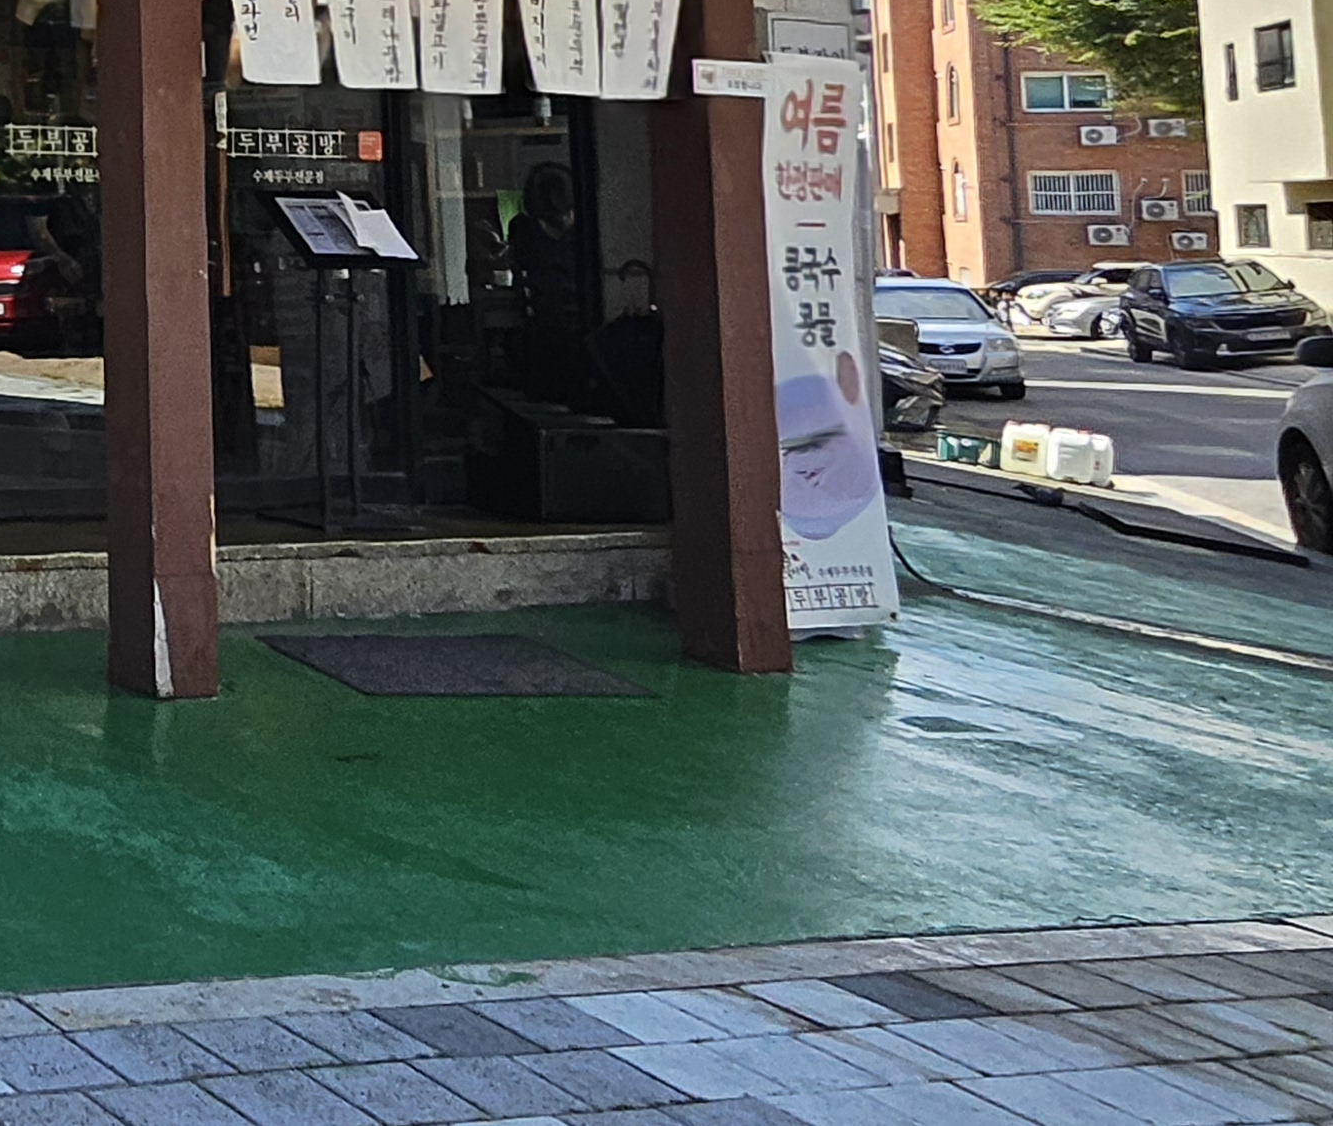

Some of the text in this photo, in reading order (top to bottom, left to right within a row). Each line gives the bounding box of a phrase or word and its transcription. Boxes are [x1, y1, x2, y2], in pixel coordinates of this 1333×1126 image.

[780, 78, 847, 155] 여름
[238, 133, 336, 155] 두부공방
[781, 247, 842, 295] 콩국수
[794, 302, 837, 348] 콩물
[793, 585, 869, 608] 두부공방
